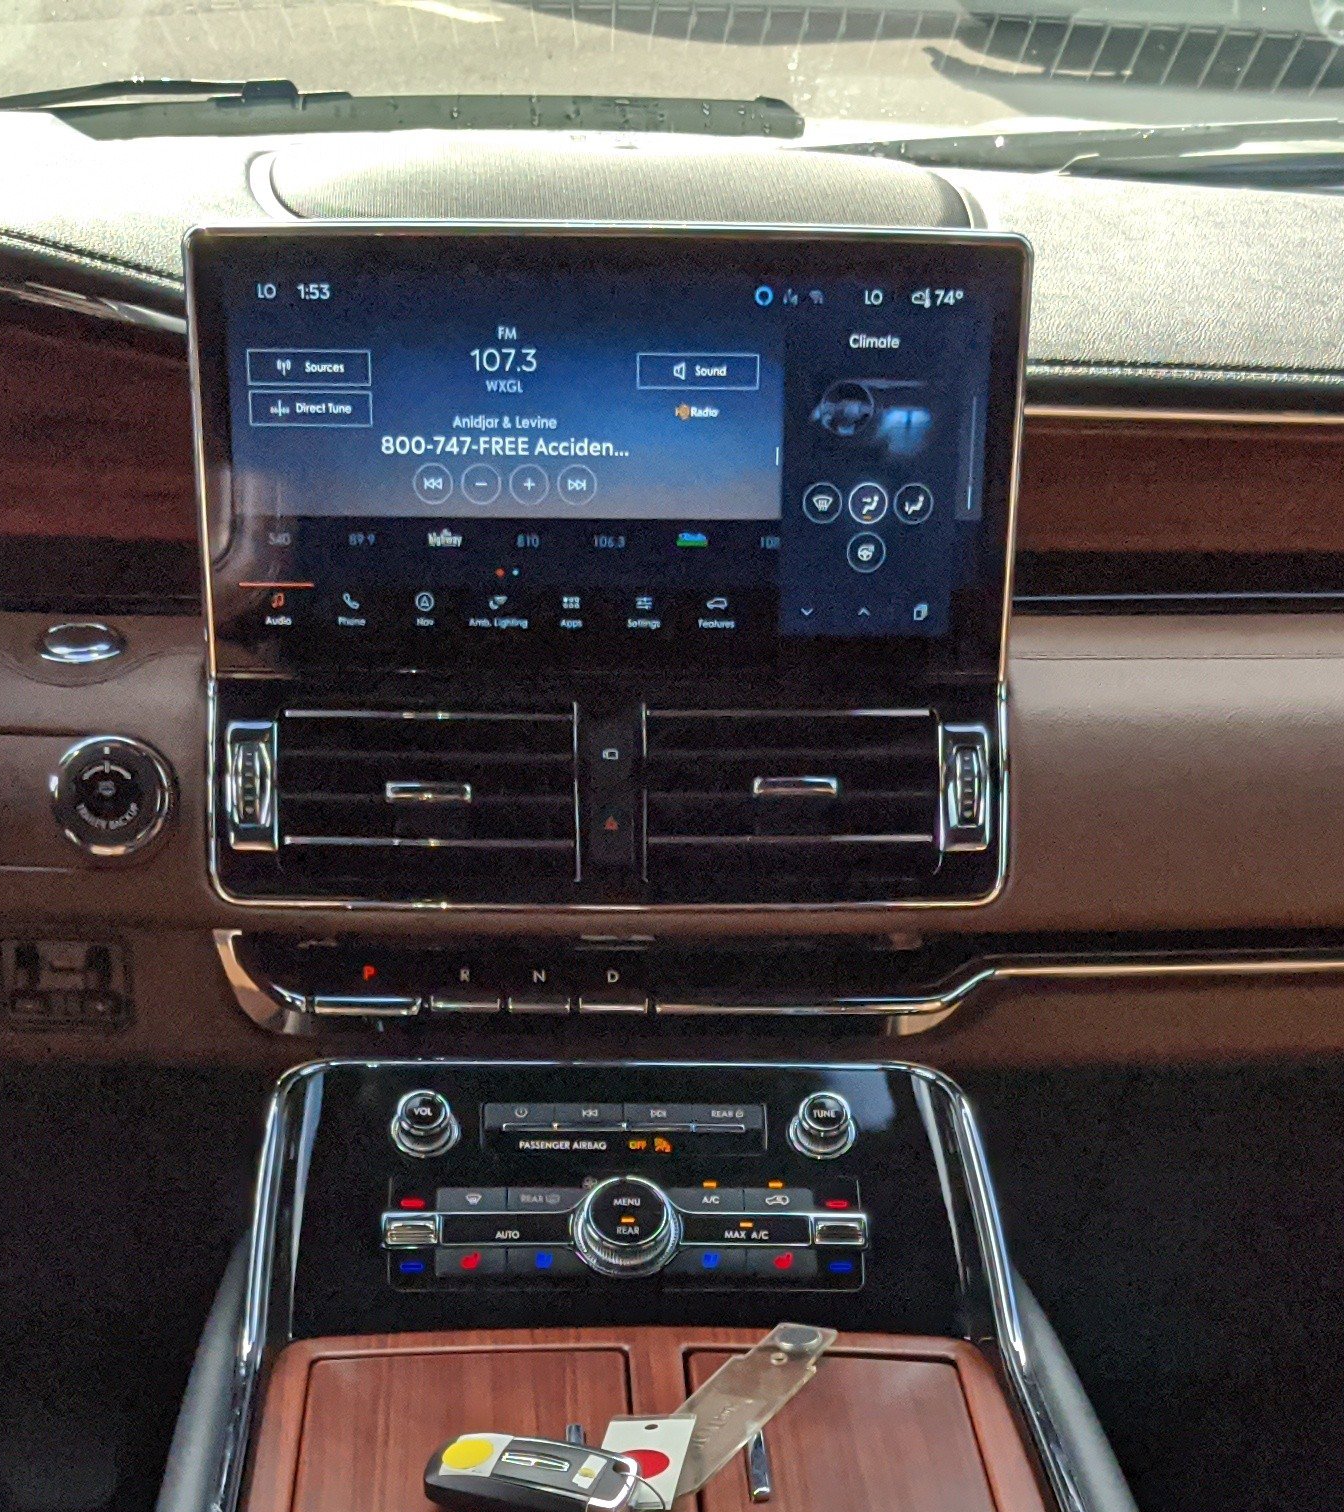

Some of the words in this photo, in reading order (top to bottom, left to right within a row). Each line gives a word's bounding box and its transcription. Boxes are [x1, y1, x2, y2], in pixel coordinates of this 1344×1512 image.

[258, 284, 276, 299] LO
[297, 284, 331, 300] 1:53
[864, 290, 883, 305] LO
[497, 326, 517, 340] FM
[849, 332, 901, 350] Climate
[304, 361, 345, 374] Sources
[469, 348, 538, 373] 107.3
[694, 365, 727, 377] Sound
[485, 380, 524, 394] WXGL
[296, 402, 326, 414] Direct
[328, 402, 352, 415] Tune
[501, 416, 512, 429] &
[515, 416, 558, 430] Levine
[380, 436, 530, 456] 800-747-FREE
[534, 438, 630, 458] Acciden...
[363, 964, 377, 981] P
[460, 968, 471, 983] R
[533, 969, 546, 983] N
[607, 969, 620, 984] D
[413, 1106, 433, 1117] VOL
[812, 1108, 836, 1119] TUNE
[518, 1140, 570, 1151] PASSENGER
[572, 1140, 607, 1151] AIRBAG
[613, 1197, 641, 1207] MENU
[701, 1195, 720, 1205] A/C
[494, 1230, 521, 1240] AUTO
[616, 1226, 641, 1236] REAR
[723, 1230, 747, 1240] MAX
[750, 1230, 770, 1240] A/C
